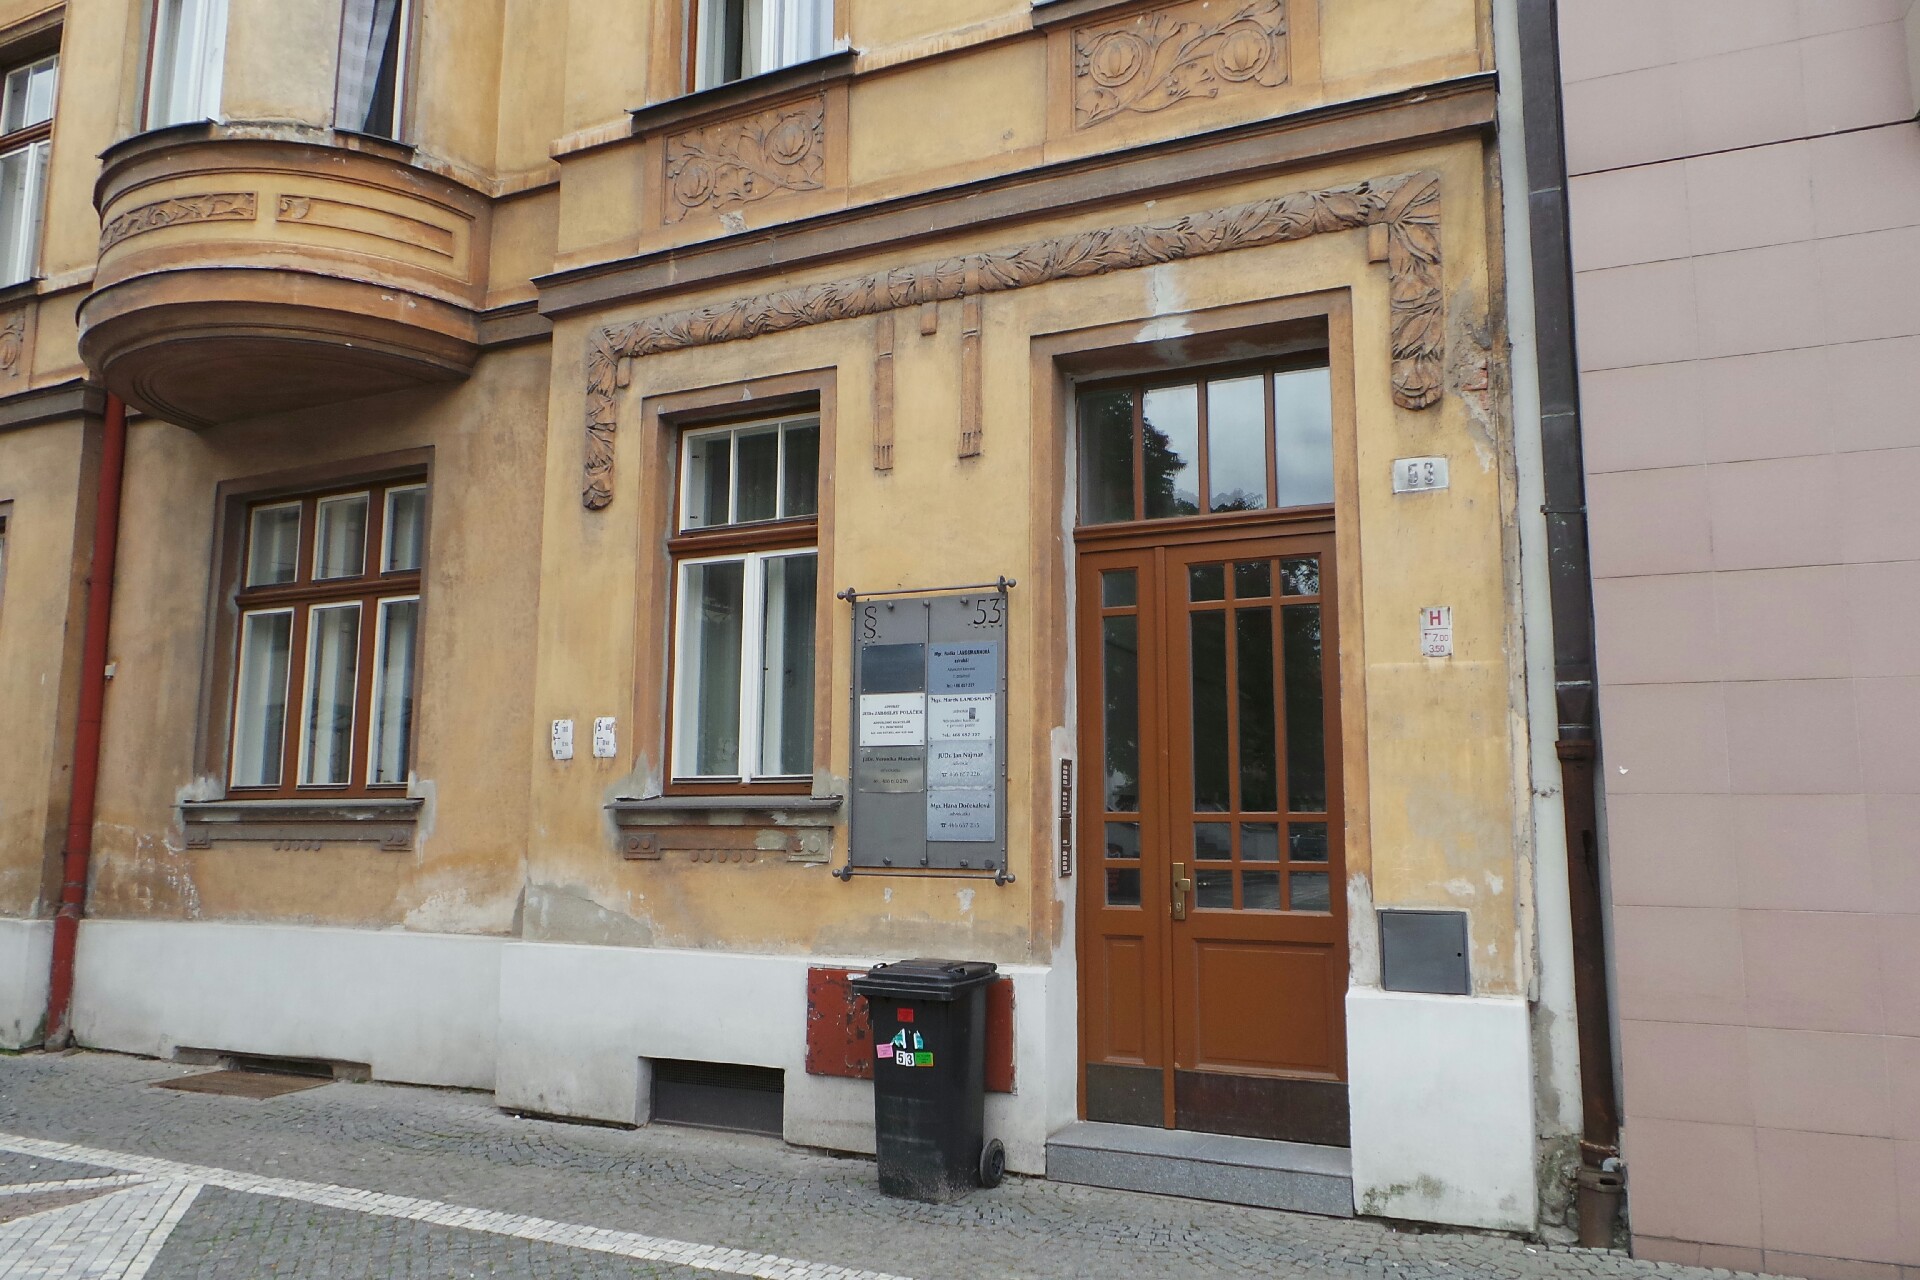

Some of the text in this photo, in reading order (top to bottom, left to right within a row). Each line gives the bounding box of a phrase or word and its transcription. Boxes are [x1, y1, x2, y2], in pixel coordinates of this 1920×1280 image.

[1407, 462, 1434, 484] 53
[973, 598, 1001, 625] 53
[1429, 609, 1441, 625] H
[898, 1053, 913, 1065] 53
